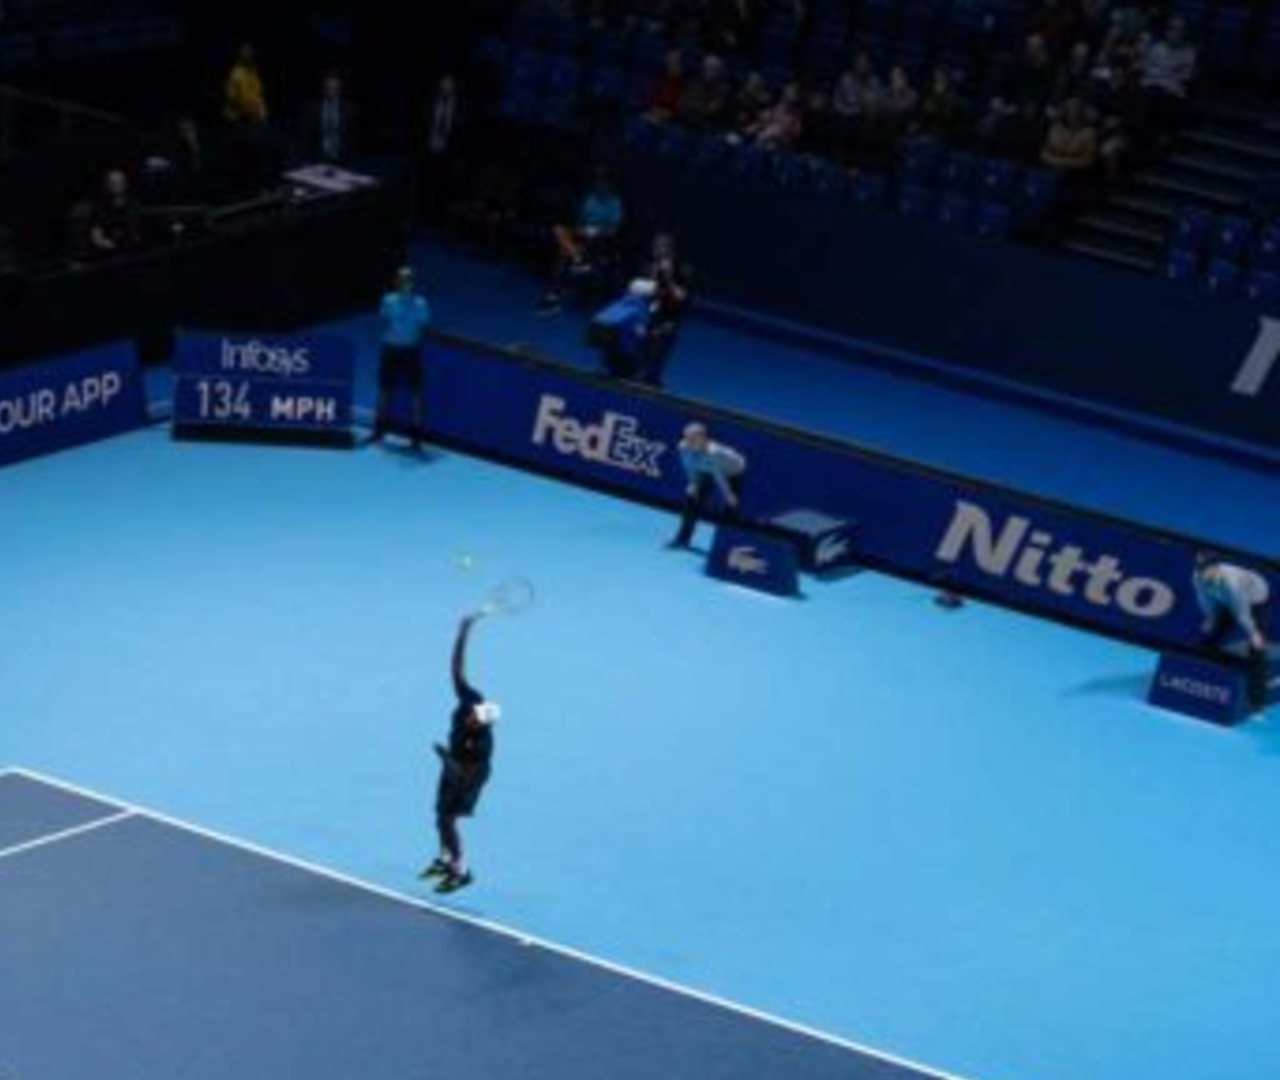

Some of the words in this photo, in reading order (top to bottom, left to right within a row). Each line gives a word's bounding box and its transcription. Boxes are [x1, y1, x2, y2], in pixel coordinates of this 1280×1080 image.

[221, 336, 312, 375] Infosys
[60, 370, 122, 417] APP
[197, 379, 252, 420] 134
[270, 396, 336, 422] MPH
[532, 393, 666, 478] FedEx
[934, 499, 1176, 617] Nitto
